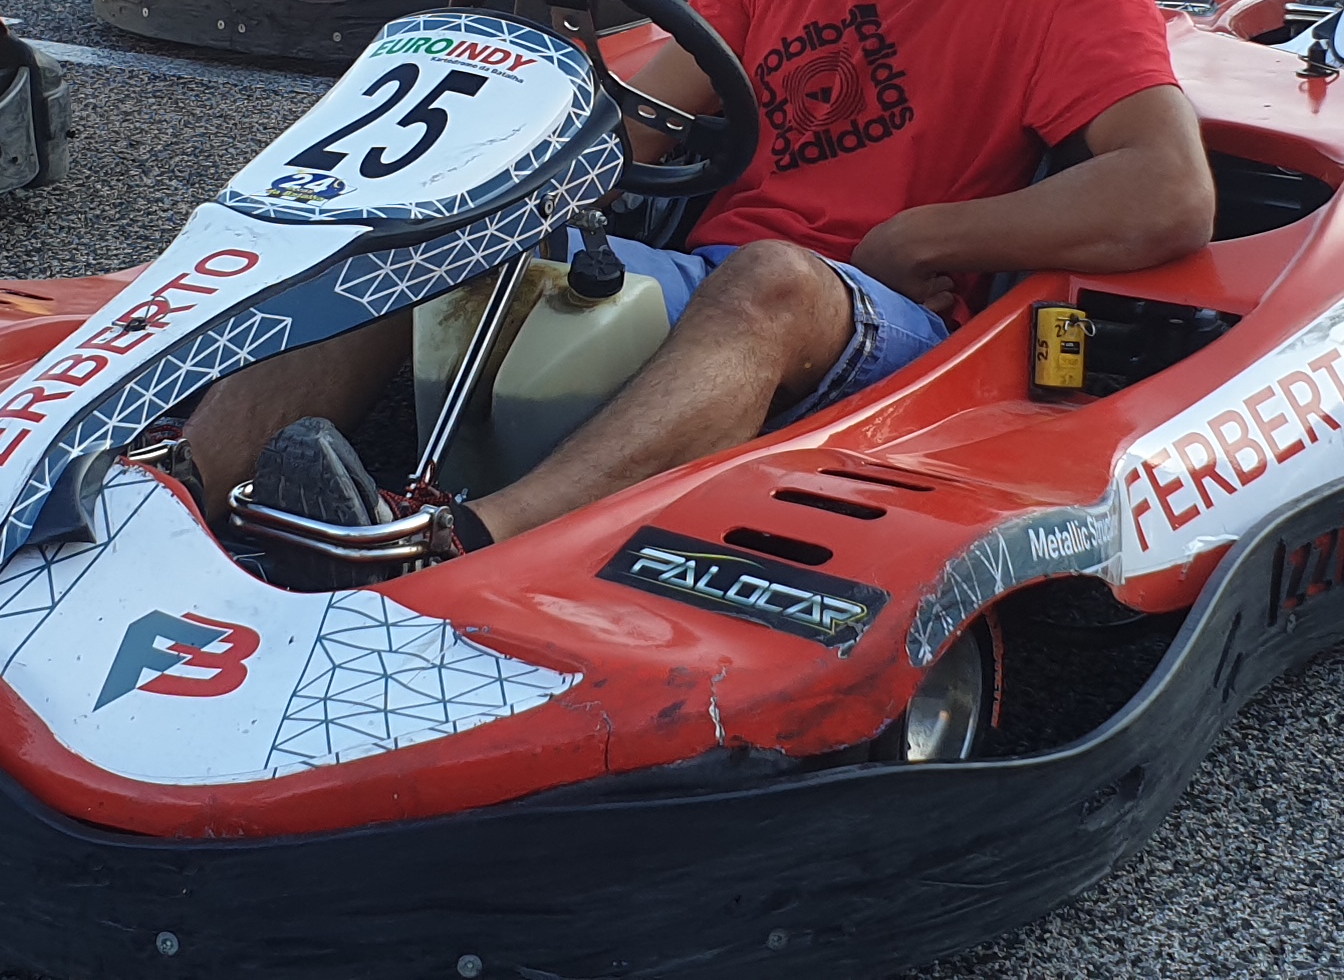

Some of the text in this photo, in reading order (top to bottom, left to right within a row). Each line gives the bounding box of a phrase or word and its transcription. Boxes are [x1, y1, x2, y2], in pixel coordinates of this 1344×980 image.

[369, 36, 538, 72] EUROINDY
[285, 61, 489, 180] 25
[278, 173, 336, 193] 24
[1037, 339, 1049, 362] 25
[1027, 518, 1089, 562] Metallic
[630, 547, 863, 629] PALOCAR
